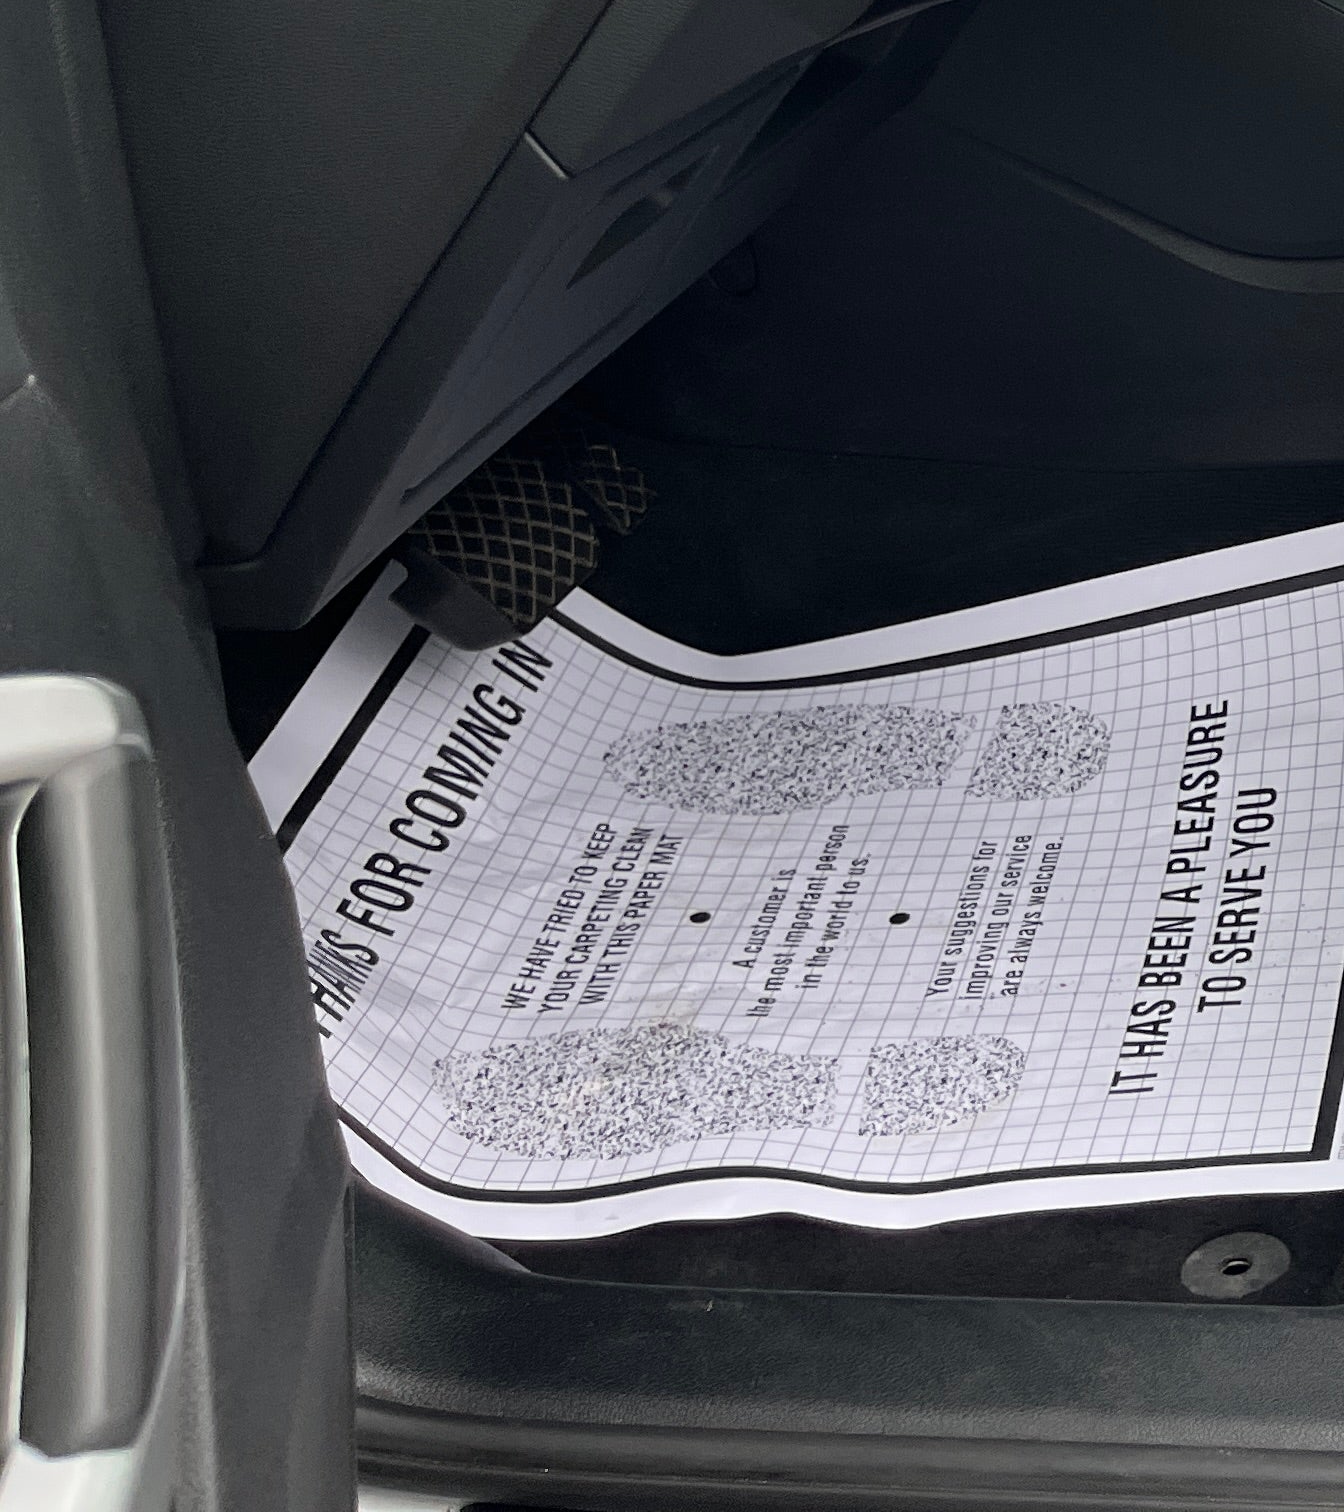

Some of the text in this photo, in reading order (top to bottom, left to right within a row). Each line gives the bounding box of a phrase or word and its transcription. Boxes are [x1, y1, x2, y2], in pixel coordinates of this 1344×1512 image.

[337, 852, 431, 937] FOR
[389, 684, 526, 853] COMING
[492, 639, 554, 693] IN
[501, 824, 617, 1008] WE HAVE TRIED TO KEEP
[538, 827, 654, 1013] YOUR CARPETING CLEAN
[578, 834, 684, 1005] WITH THIS PAPER MAT
[732, 869, 797, 969] A customer is
[746, 825, 849, 1017] the most important person
[795, 853, 871, 989] in the world to us.
[925, 841, 998, 998] Your suggestions for
[959, 835, 1032, 1000] improving our service
[1001, 837, 1064, 997] are always welcome.
[1109, 700, 1229, 1095] IT HAS BEEN A PLEASURE
[1197, 788, 1278, 1013] TO SERVE YOU
